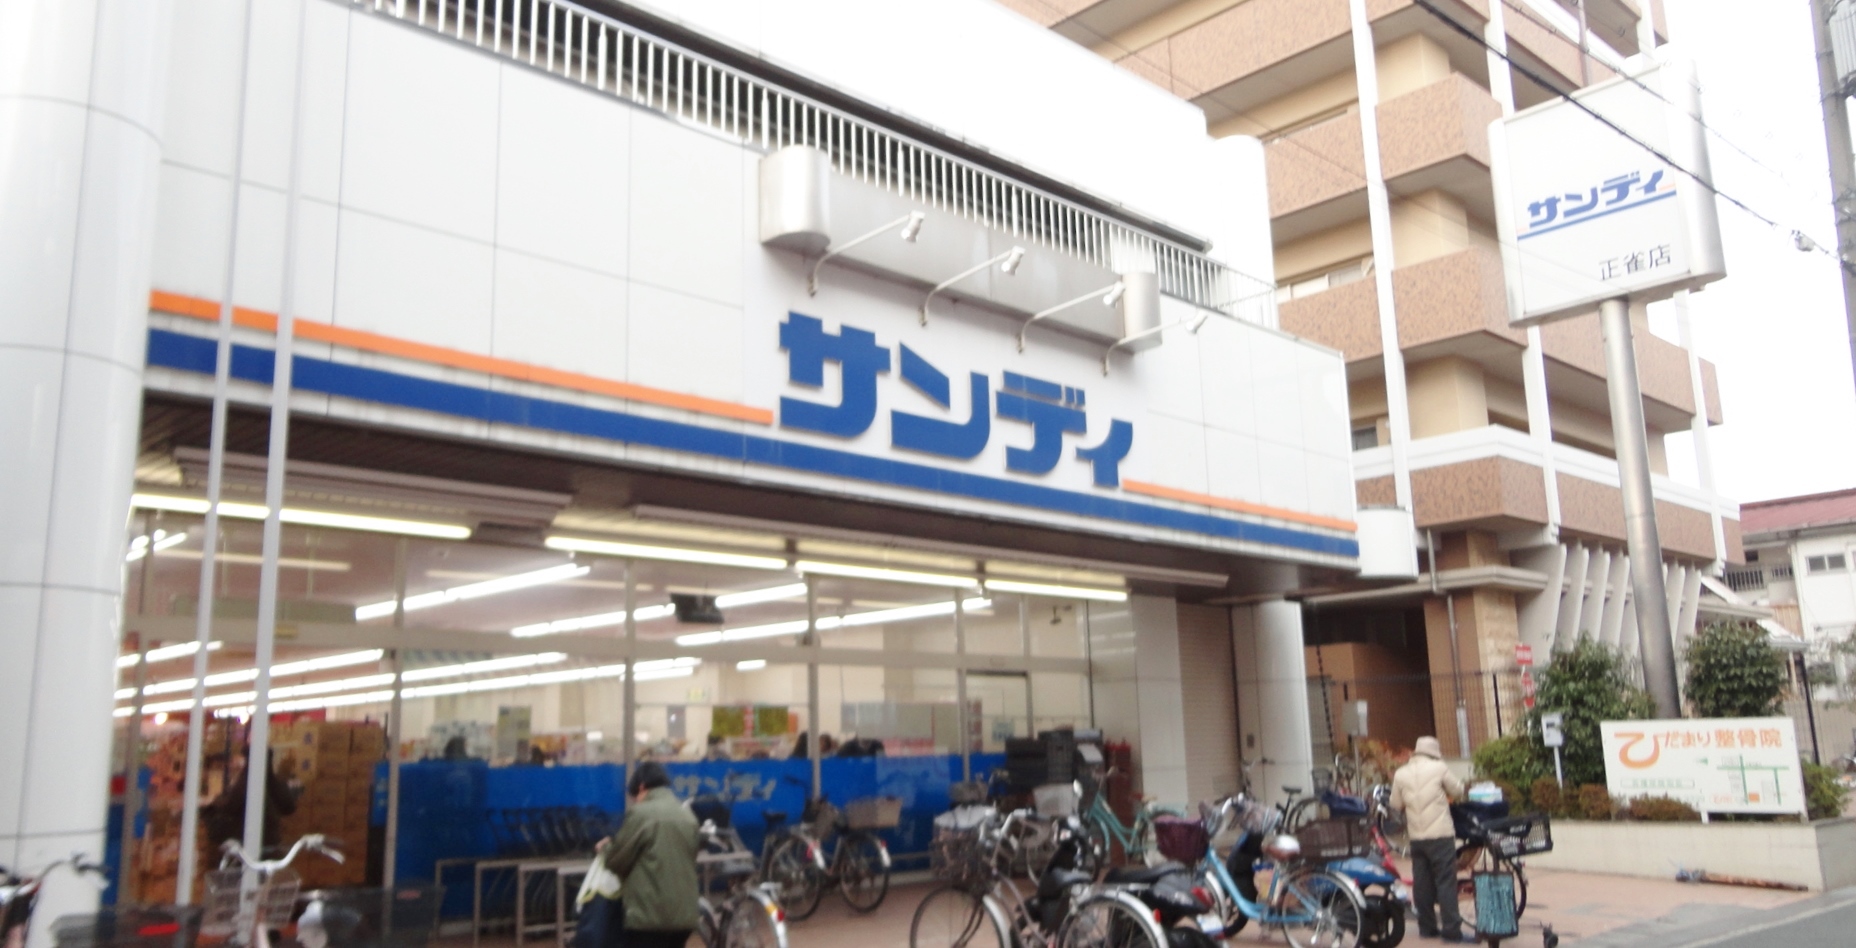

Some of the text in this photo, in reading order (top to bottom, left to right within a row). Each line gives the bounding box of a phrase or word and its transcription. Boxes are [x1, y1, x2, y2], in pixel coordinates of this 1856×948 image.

[1527, 169, 1664, 229] サンディ
[1599, 244, 1672, 281] 正雀店
[779, 310, 1134, 488] サンディ
[1614, 728, 1782, 770] ひだまり整骨院
